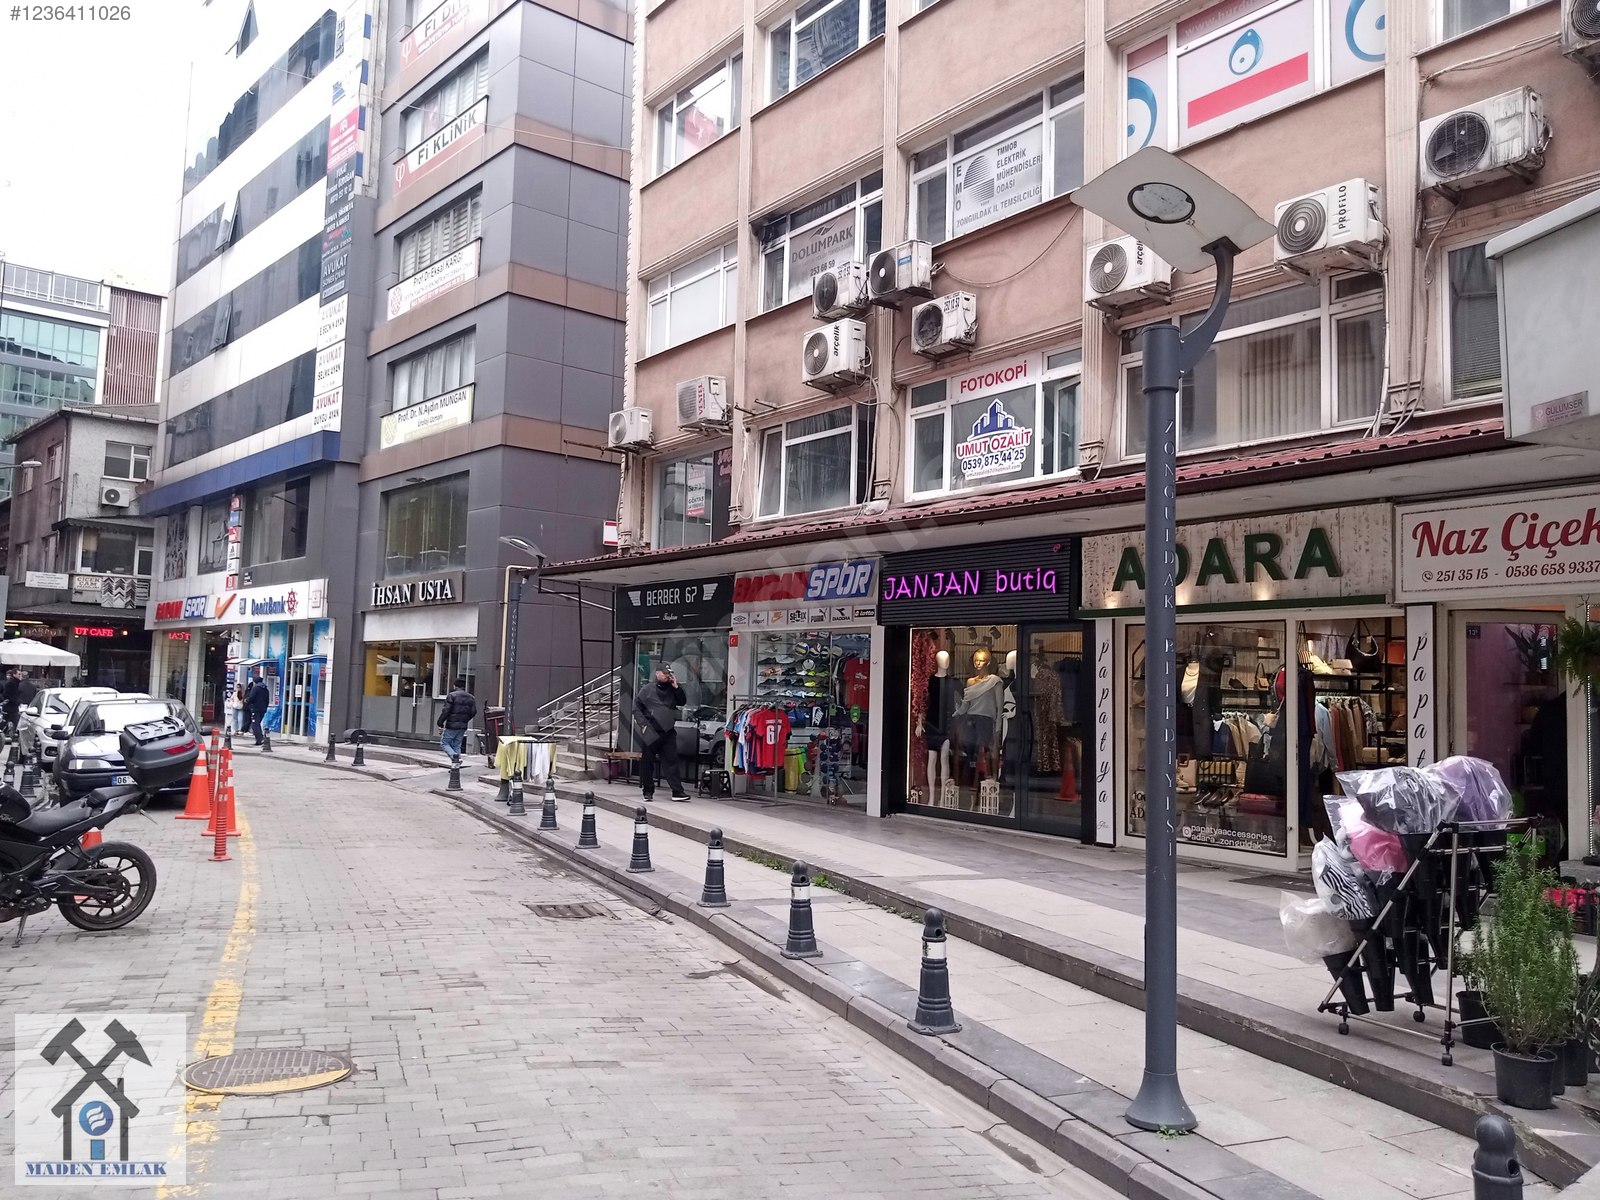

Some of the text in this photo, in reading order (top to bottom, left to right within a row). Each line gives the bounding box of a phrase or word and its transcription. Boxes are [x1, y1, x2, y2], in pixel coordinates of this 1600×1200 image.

[997, 141, 1018, 156] TMMOB
[997, 148, 1026, 169] ELEKTRİK
[997, 179, 1016, 194] ODASI
[957, 207, 992, 229] ZONGULDAK
[792, 226, 854, 263] DOLUMPARK
[323, 254, 348, 277] AVUKAT
[319, 346, 342, 366] AVUKAT
[960, 360, 1027, 394] FOTOKOPİ
[316, 391, 340, 411] AVUKAT
[439, 390, 467, 408] MUNGAN
[957, 429, 1031, 458] UMUT OZALİT
[962, 449, 1025, 471] 0539 875 44 25
[1411, 519, 1490, 558] Naz
[1436, 570, 1455, 583] 251
[1457, 569, 1473, 581] 35
[1476, 568, 1489, 580] 15
[1505, 564, 1538, 578] 0536
[1541, 562, 1565, 575] 658
[371, 578, 453, 606] İHSAN USTA
[884, 567, 1057, 600] JANJAN butiq
[251, 595, 286, 616] DenizBank
[646, 586, 698, 607] BERBER 67
[184, 597, 206, 618] SPOR
[90, 628, 114, 637] CAFE
[1096, 638, 1110, 803] papatya
[117, 776, 128, 785] 06
